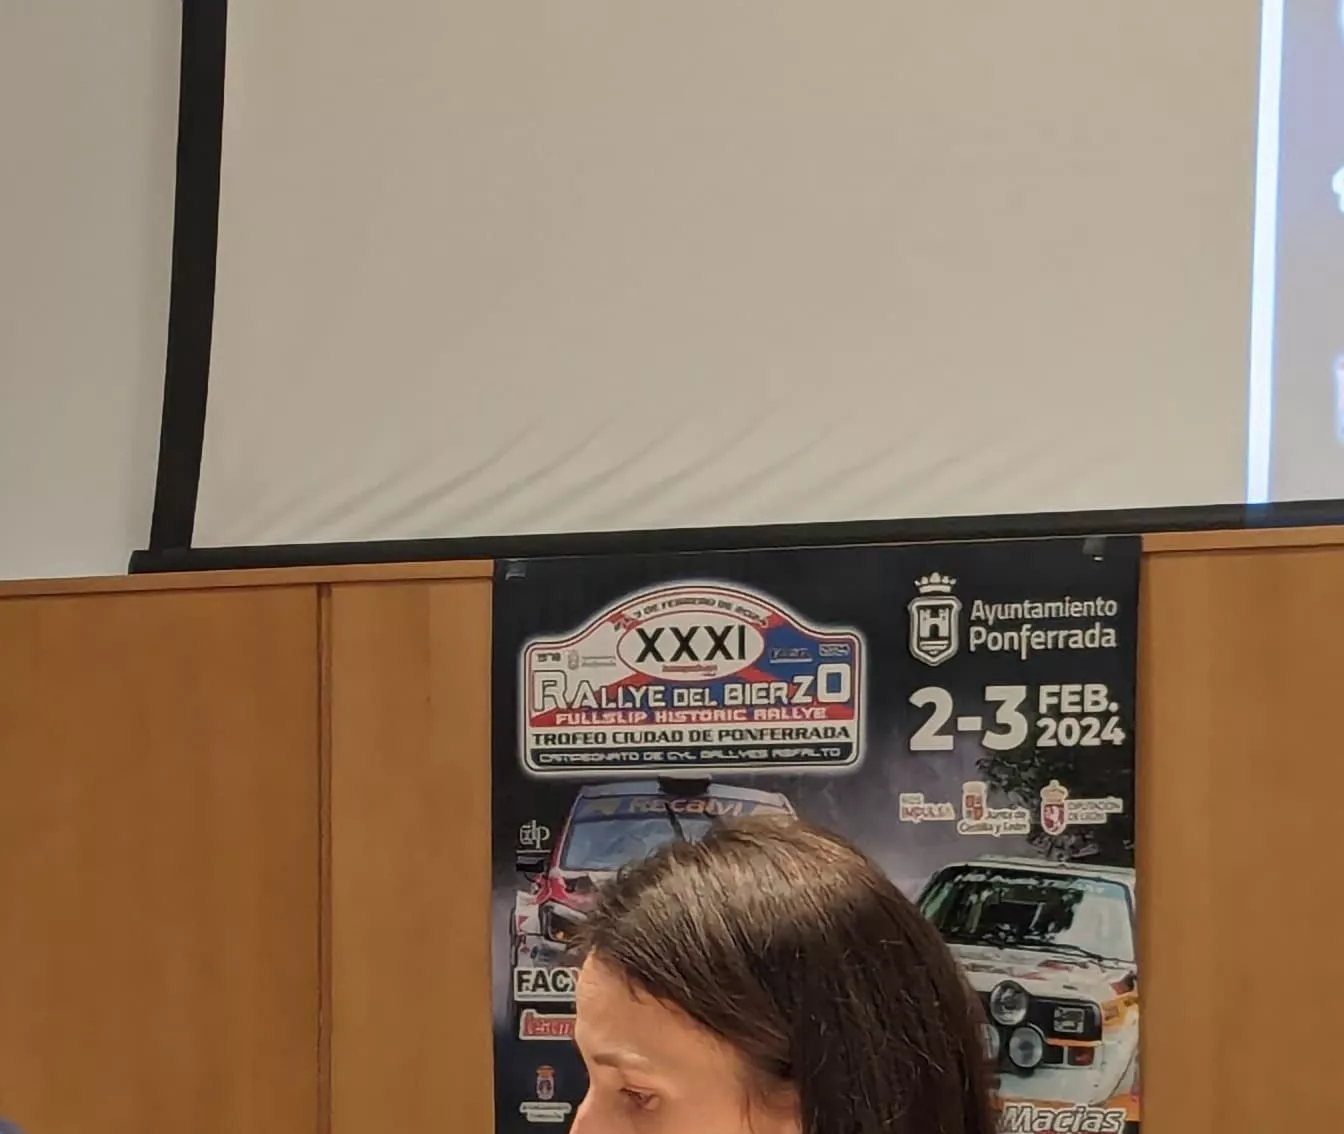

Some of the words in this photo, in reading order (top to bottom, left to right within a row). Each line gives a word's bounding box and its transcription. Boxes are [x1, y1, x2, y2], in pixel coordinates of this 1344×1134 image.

[969, 596, 1118, 626] Ayuntamiento
[634, 624, 746, 664] XXXI
[969, 623, 1117, 660] Ponferrada
[532, 670, 666, 713] RALLYE
[672, 685, 718, 708] DEL
[724, 662, 851, 706] BIERZO
[556, 709, 648, 726] FULLSLIP
[655, 707, 748, 724] HISTORIC
[753, 706, 827, 721] RALLYE
[909, 685, 1029, 751] 2-3
[1038, 683, 1121, 715] FEB.
[1035, 715, 1126, 749] 2024
[532, 730, 607, 747] TROFEO
[611, 728, 685, 744] CIUDAD
[688, 727, 716, 743] DE
[718, 725, 851, 742] PONFERRADA
[517, 968, 578, 993] FAC
